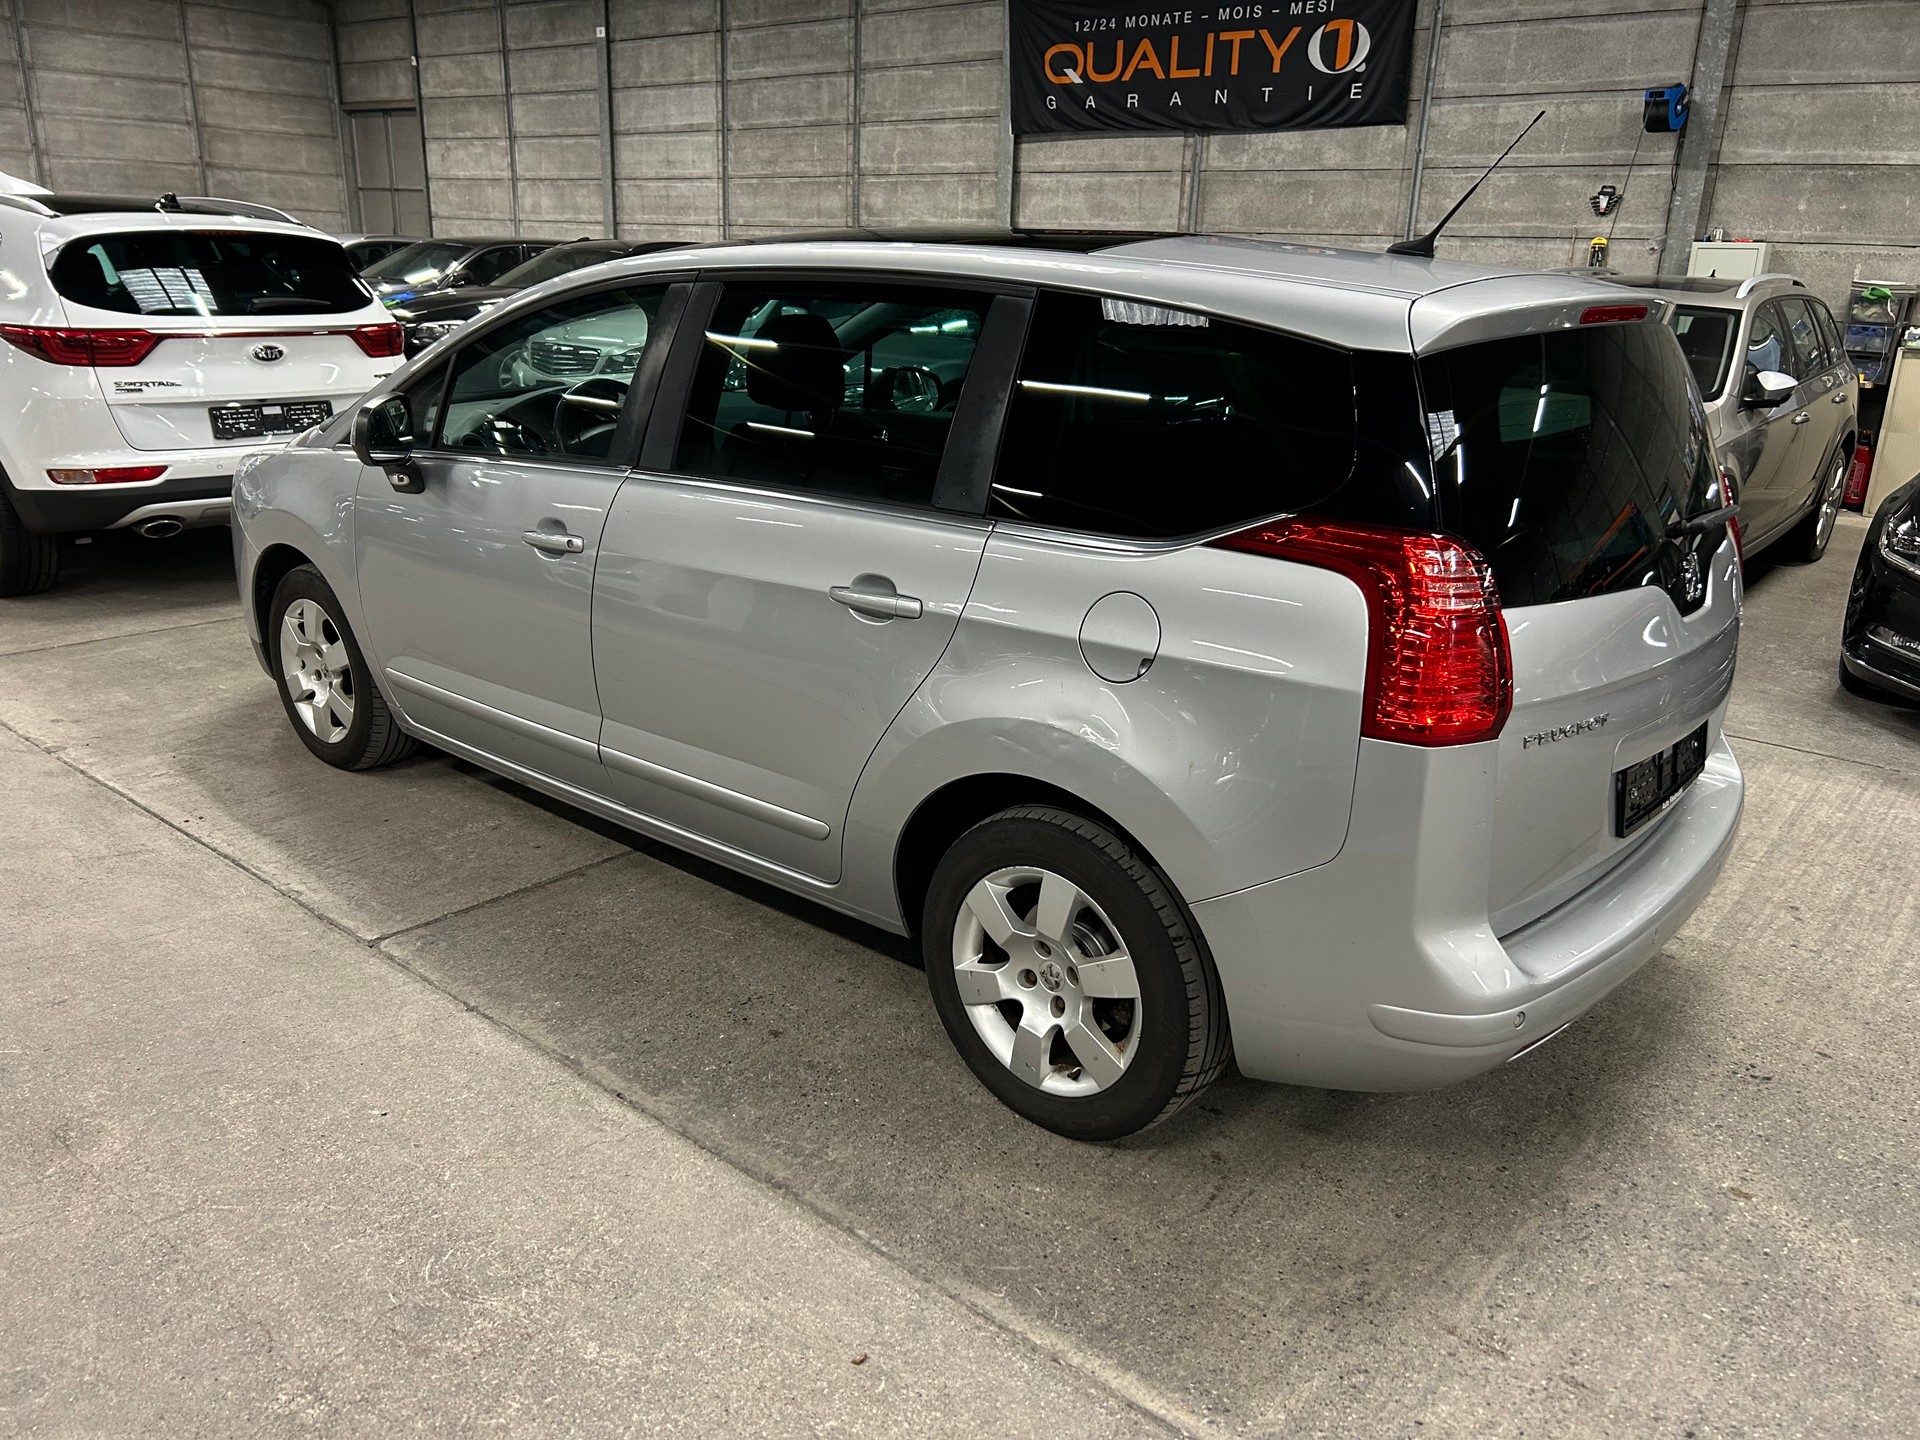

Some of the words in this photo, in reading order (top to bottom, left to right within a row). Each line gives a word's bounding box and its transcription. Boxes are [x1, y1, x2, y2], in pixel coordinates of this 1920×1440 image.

[1074, 17, 1116, 32] 12/24
[1125, 11, 1192, 28] MONATE
[1218, 4, 1262, 20] MOIS
[1290, 0, 1335, 15] MESI
[1044, 26, 1302, 84] QUALITY
[1046, 83, 1363, 110] GARANTIE
[255, 347, 281, 360] KIA
[1523, 712, 1609, 749] PEUGEOT
